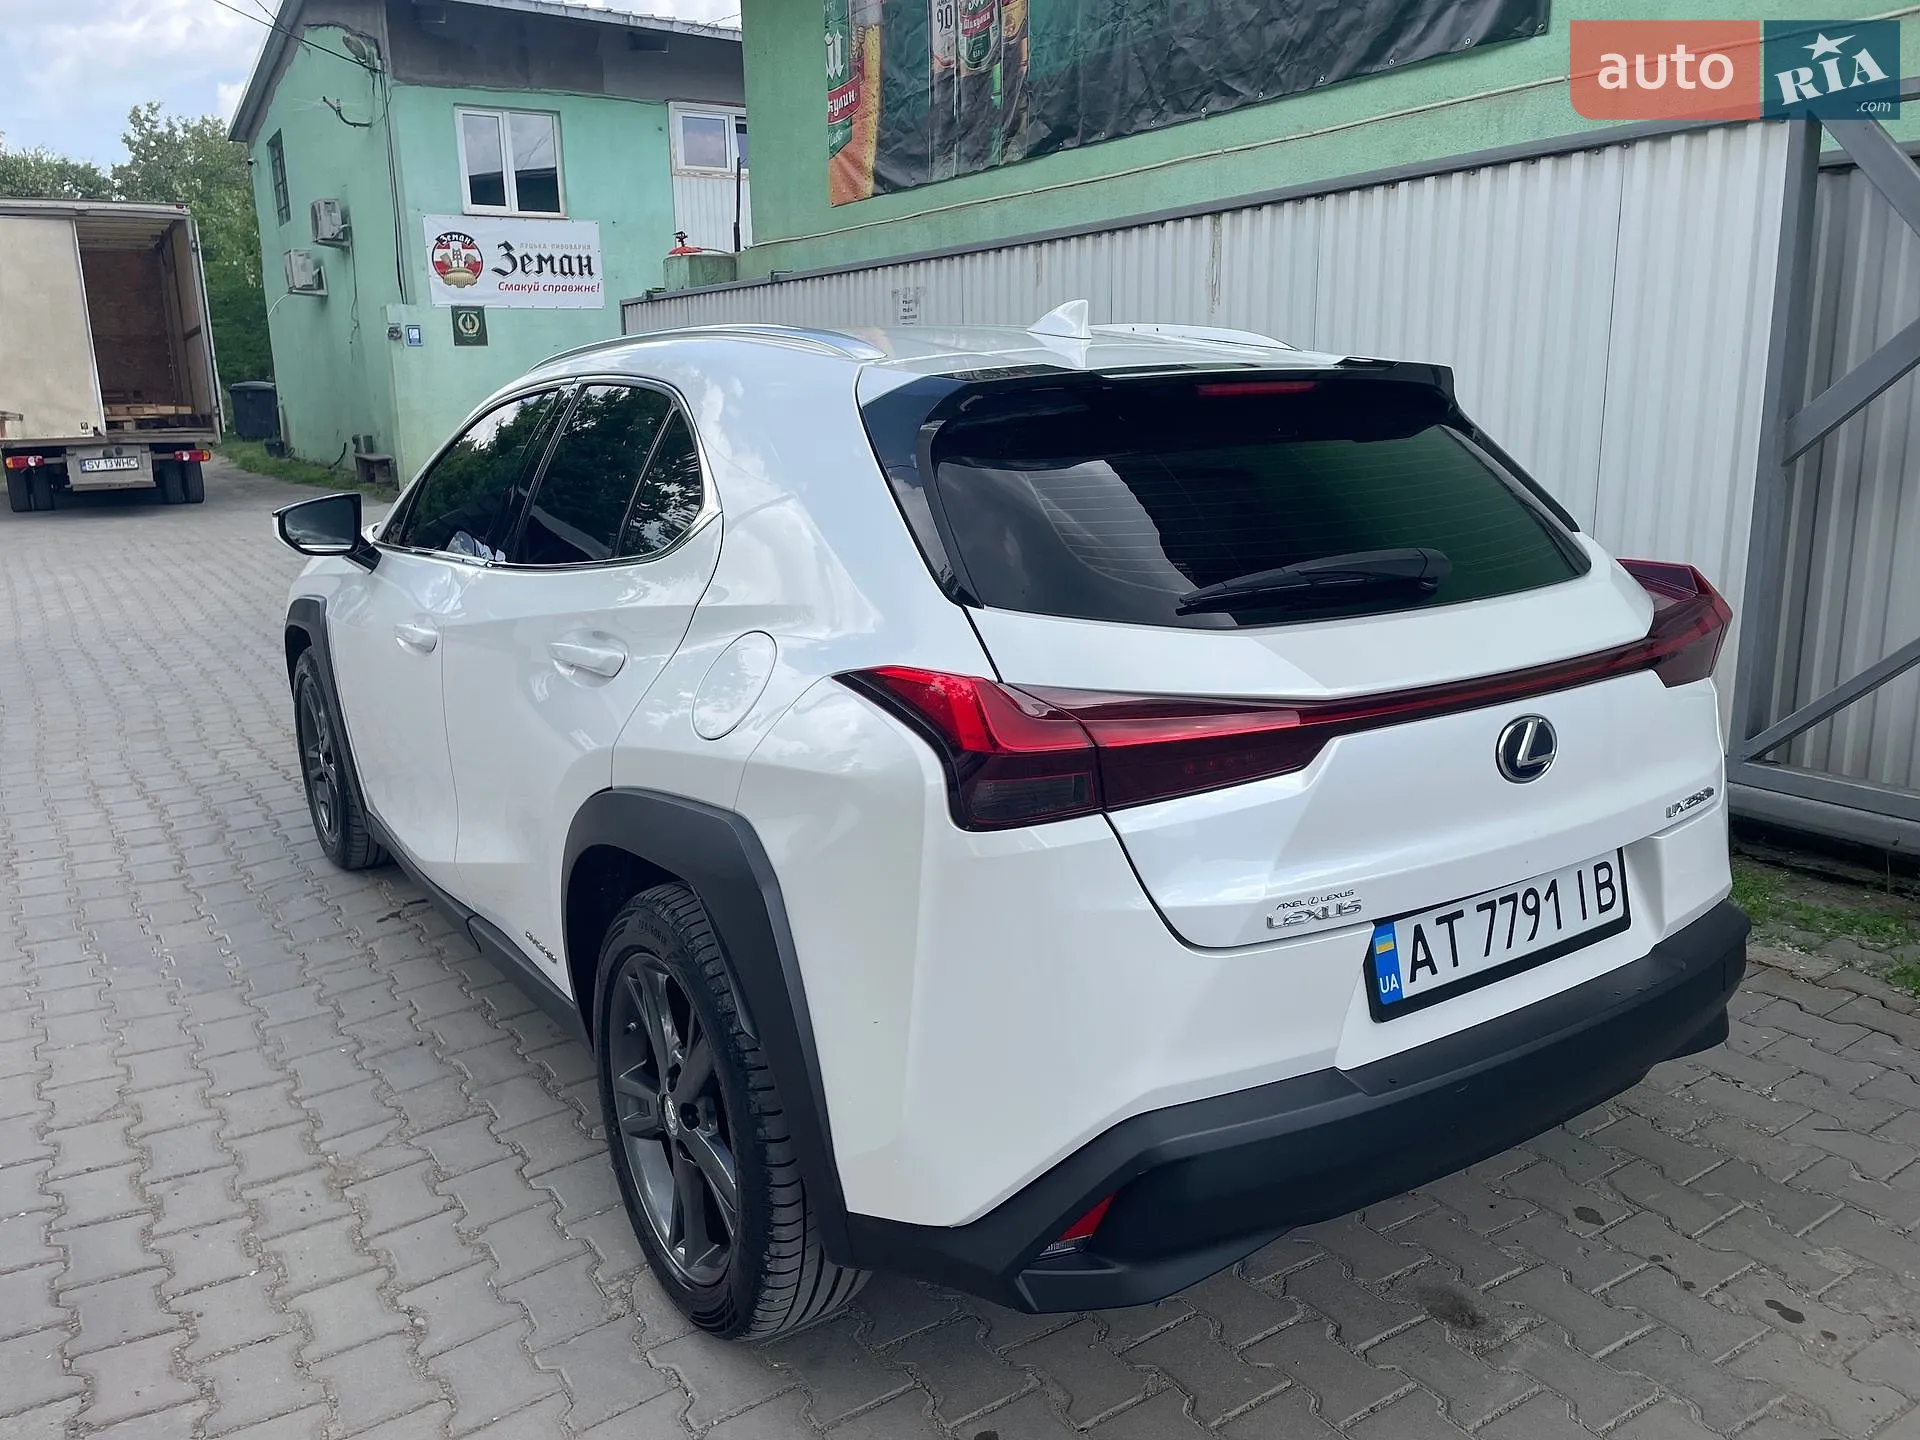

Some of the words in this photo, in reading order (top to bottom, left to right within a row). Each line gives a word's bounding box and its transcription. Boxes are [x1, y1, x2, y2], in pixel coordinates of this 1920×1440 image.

[491, 240, 595, 279] Земан
[498, 281, 540, 294] Смакуй
[542, 283, 600, 294] справжнє!
[87, 460, 100, 470] SV
[1276, 899, 1306, 910] AXEL
[1320, 889, 1354, 902] LEXUS
[1266, 899, 1362, 929] LEXUS
[1409, 909, 1465, 983] AT
[1476, 878, 1562, 957] 7791
[1577, 861, 1617, 921] IB
[1379, 973, 1400, 994] UA
